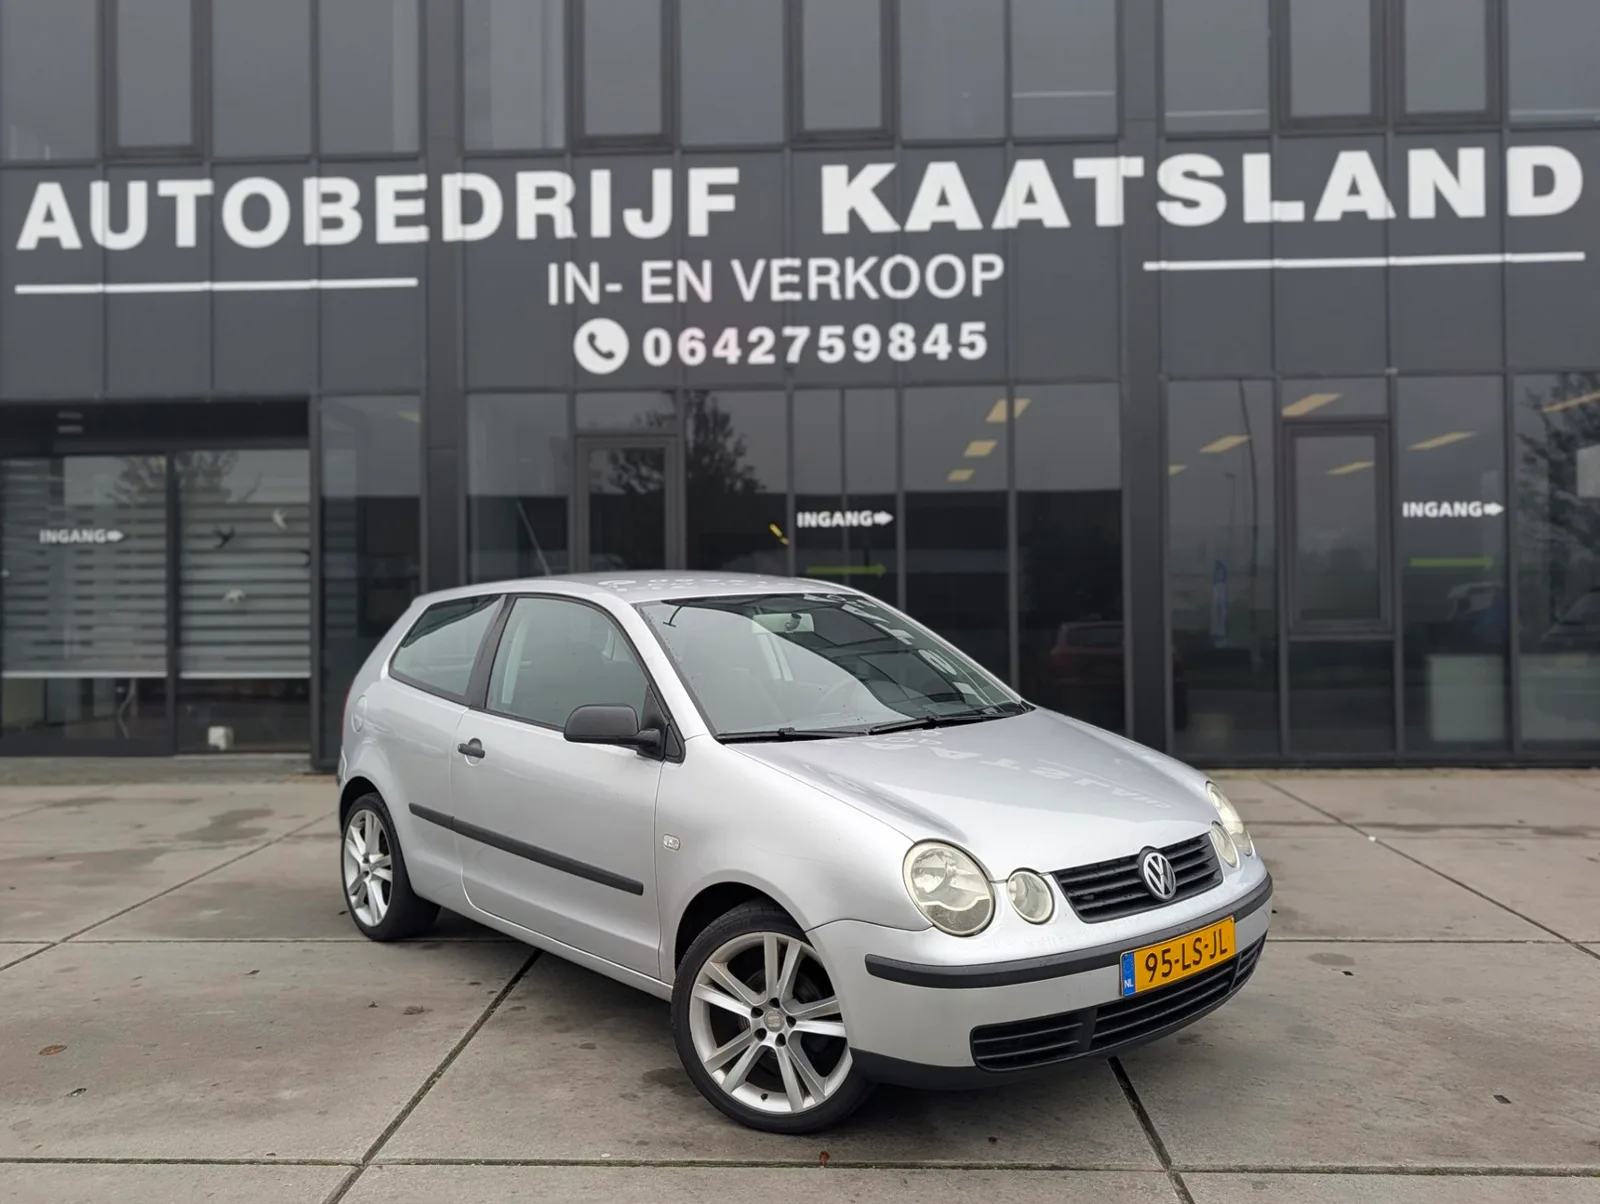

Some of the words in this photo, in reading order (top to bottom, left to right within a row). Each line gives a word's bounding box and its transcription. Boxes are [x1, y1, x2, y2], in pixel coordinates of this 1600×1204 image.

[16, 167, 740, 250] AUTOBEDRIJF
[821, 146, 1584, 234] KAATSLAND
[548, 261, 622, 306] IN-
[642, 259, 712, 304] EN
[731, 253, 1005, 303] VERKOOP
[643, 321, 988, 366] 0642759845
[797, 510, 873, 528] INGANG
[1402, 501, 1482, 518] INGANG
[39, 528, 106, 544] INGANG
[1145, 928, 1228, 983] 95-LS-JL
